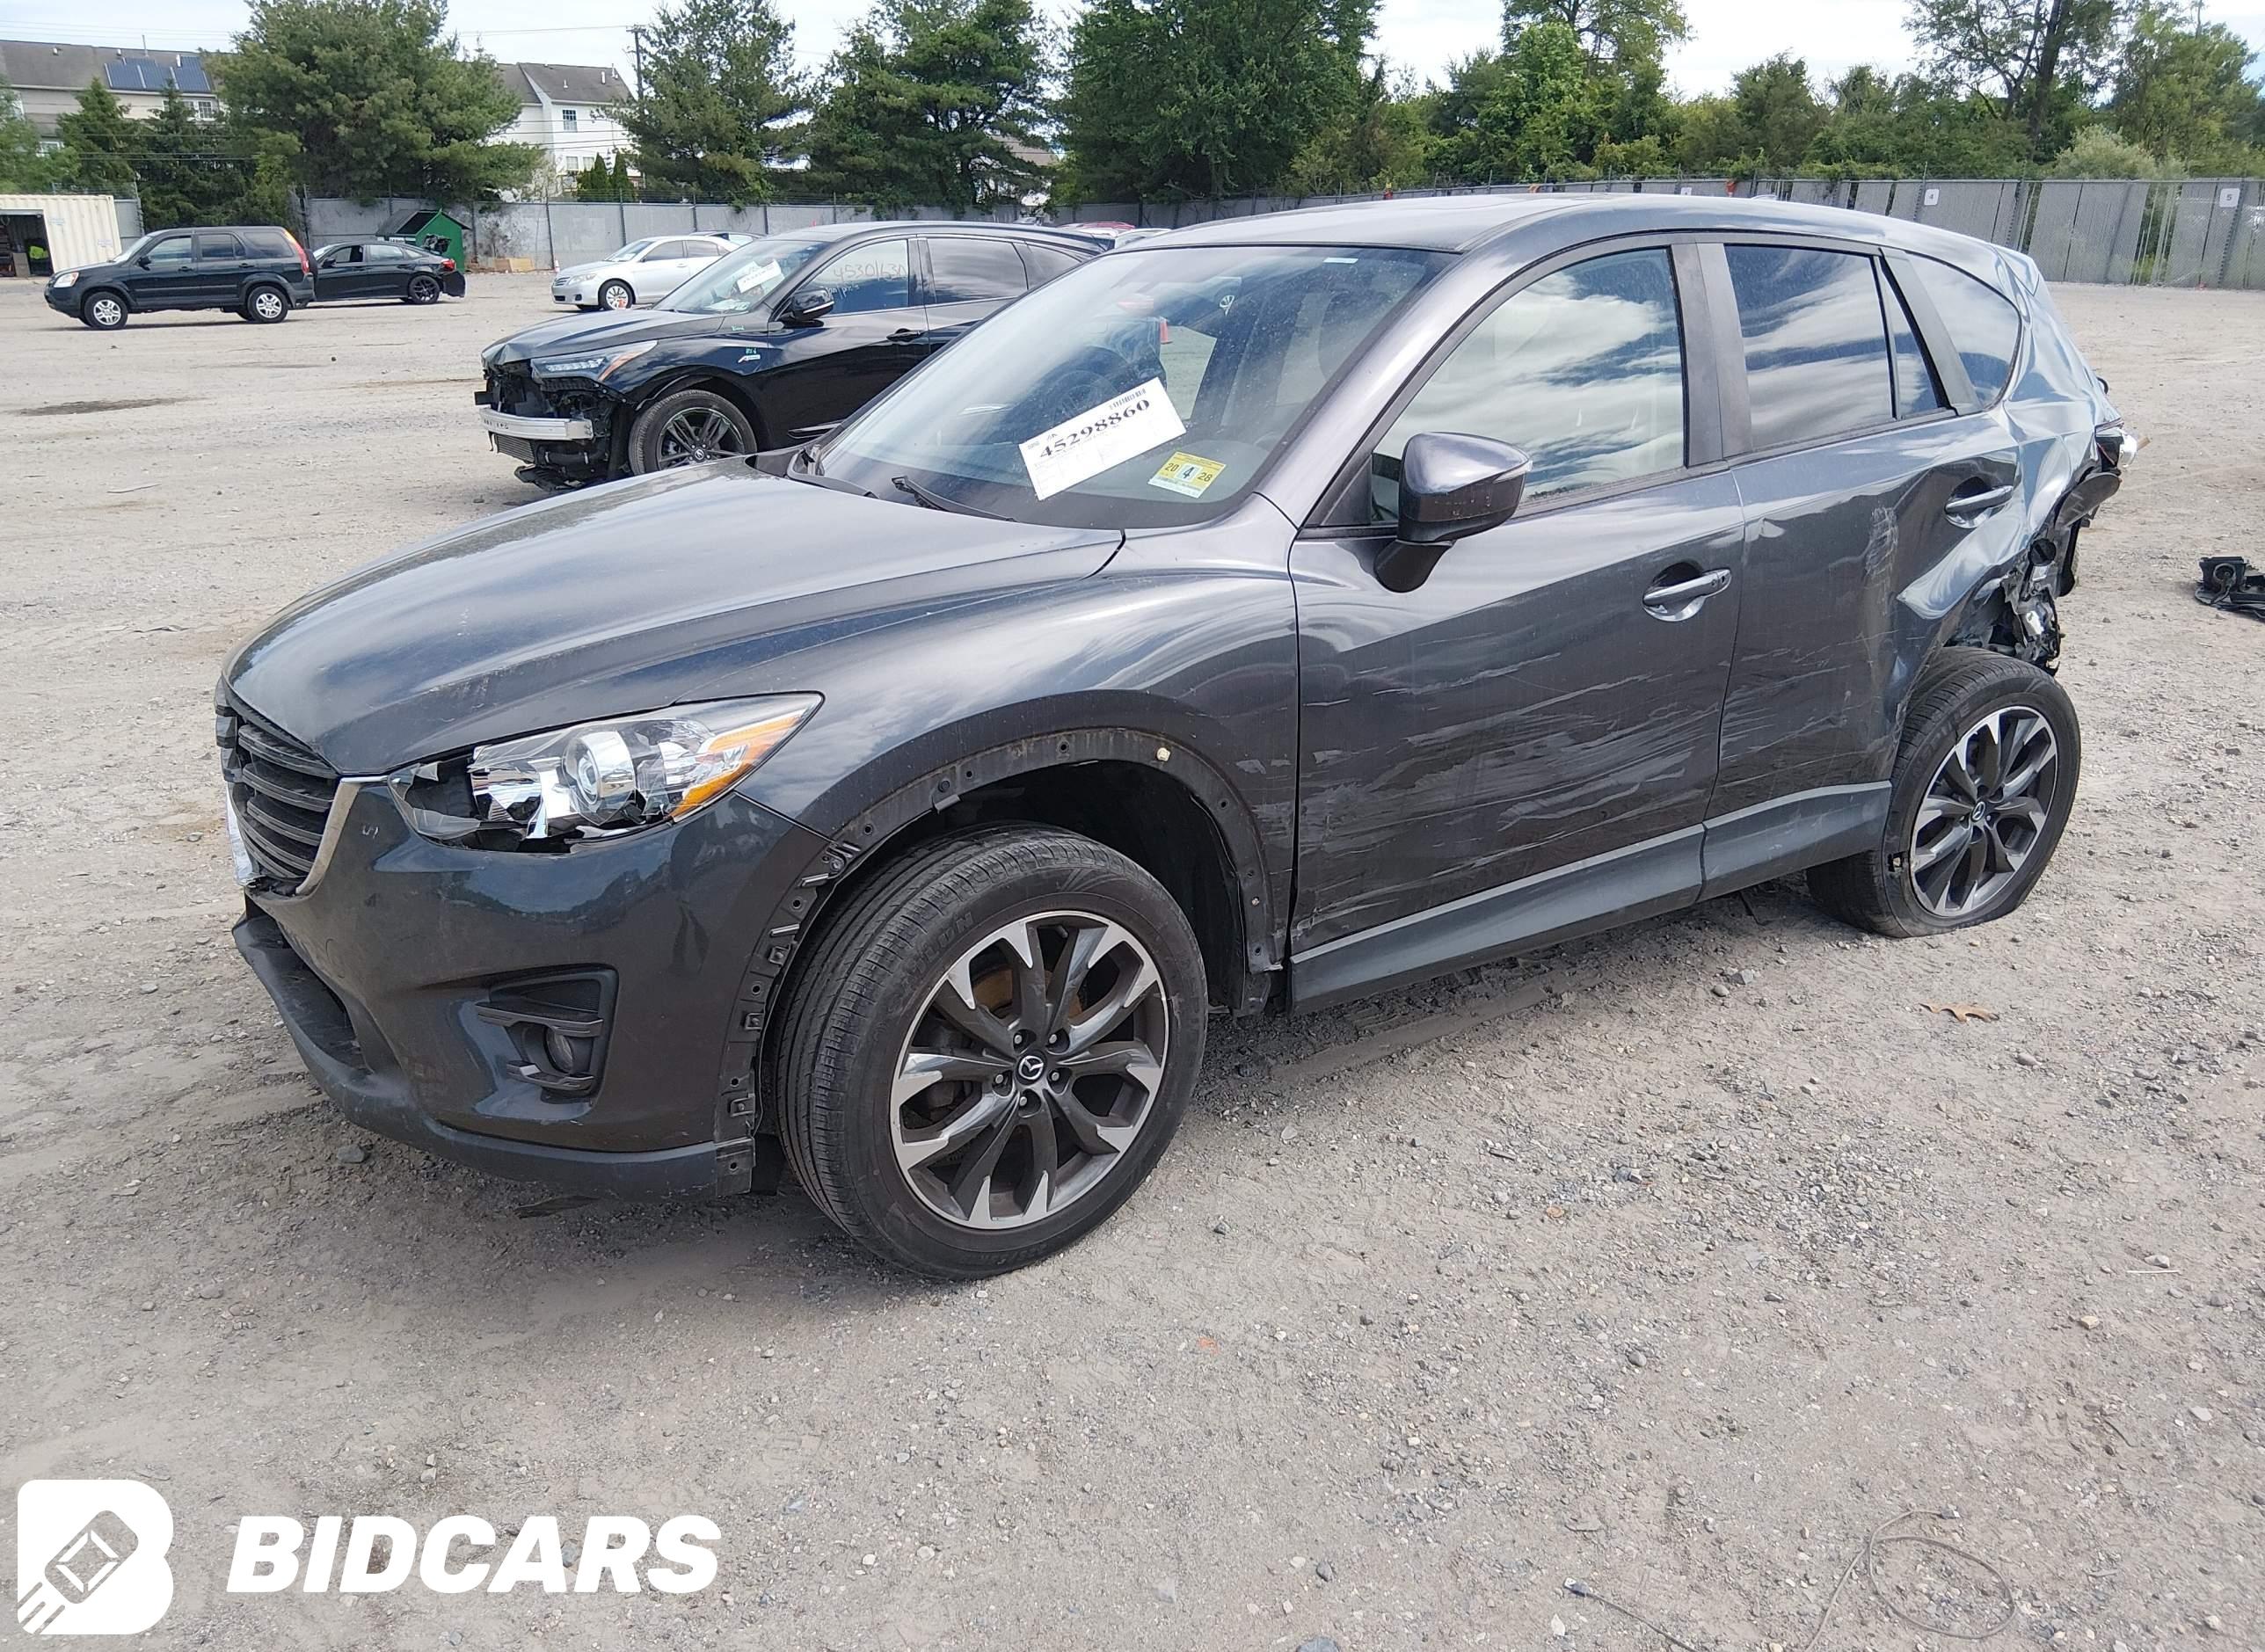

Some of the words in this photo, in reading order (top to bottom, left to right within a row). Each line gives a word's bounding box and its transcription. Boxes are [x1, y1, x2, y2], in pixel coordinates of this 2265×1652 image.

[1039, 399, 1150, 457] 45298860
[1165, 462, 1179, 472] 20
[1183, 466, 1195, 479] 4
[1198, 472, 1213, 483] 28
